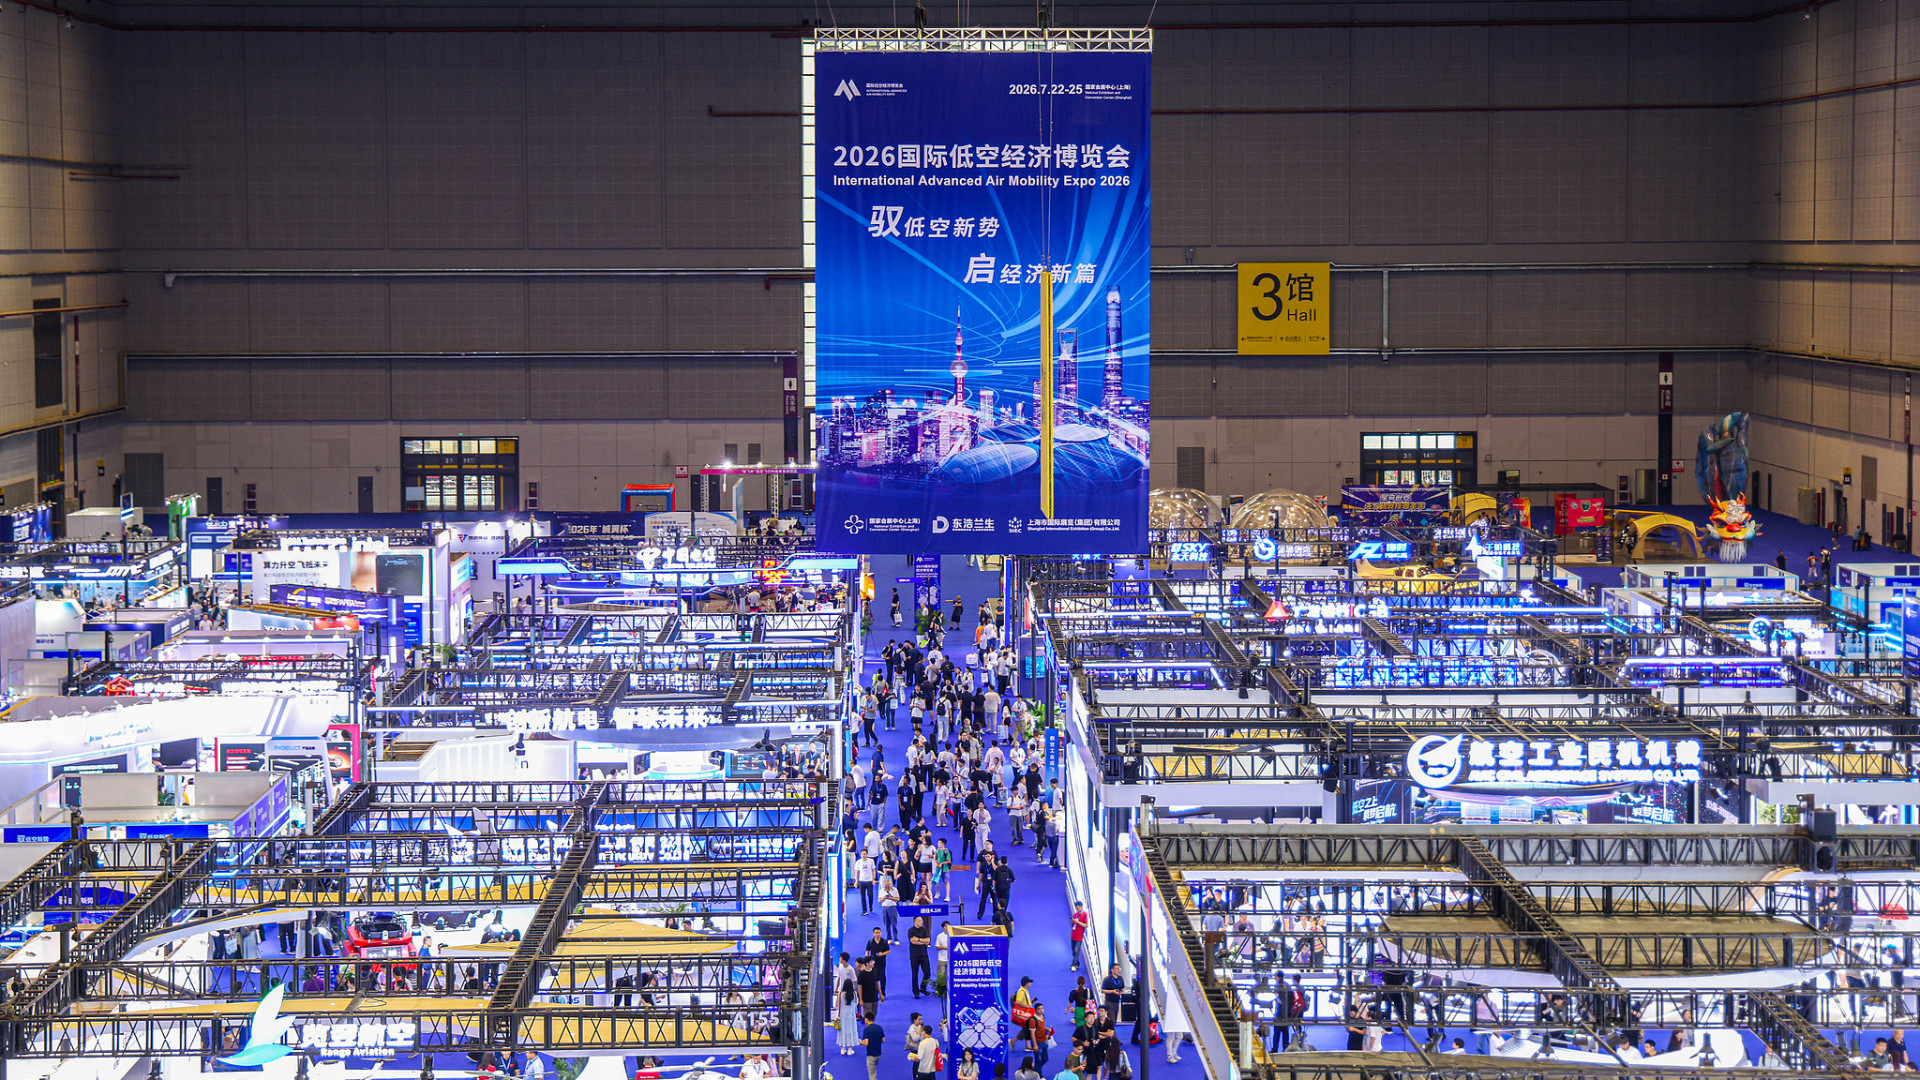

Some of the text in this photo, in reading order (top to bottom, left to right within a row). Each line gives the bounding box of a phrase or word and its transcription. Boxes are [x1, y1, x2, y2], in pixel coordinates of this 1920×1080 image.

[1009, 84, 1083, 95] 2026.7.22-25
[833, 144, 1130, 169] 2026国际低空经济博览会
[833, 175, 1130, 189] International Advanced Air Mobility Expo 2026
[1252, 273, 1315, 321] 3 馆
[1287, 309, 1316, 321] Hall
[952, 518, 994, 528] 东浩兰生
[953, 959, 1002, 967] 2026国际低空
[953, 967, 992, 976] 经济博览会
[731, 1011, 780, 1027] A155
[353, 1047, 394, 1056] Aviation
